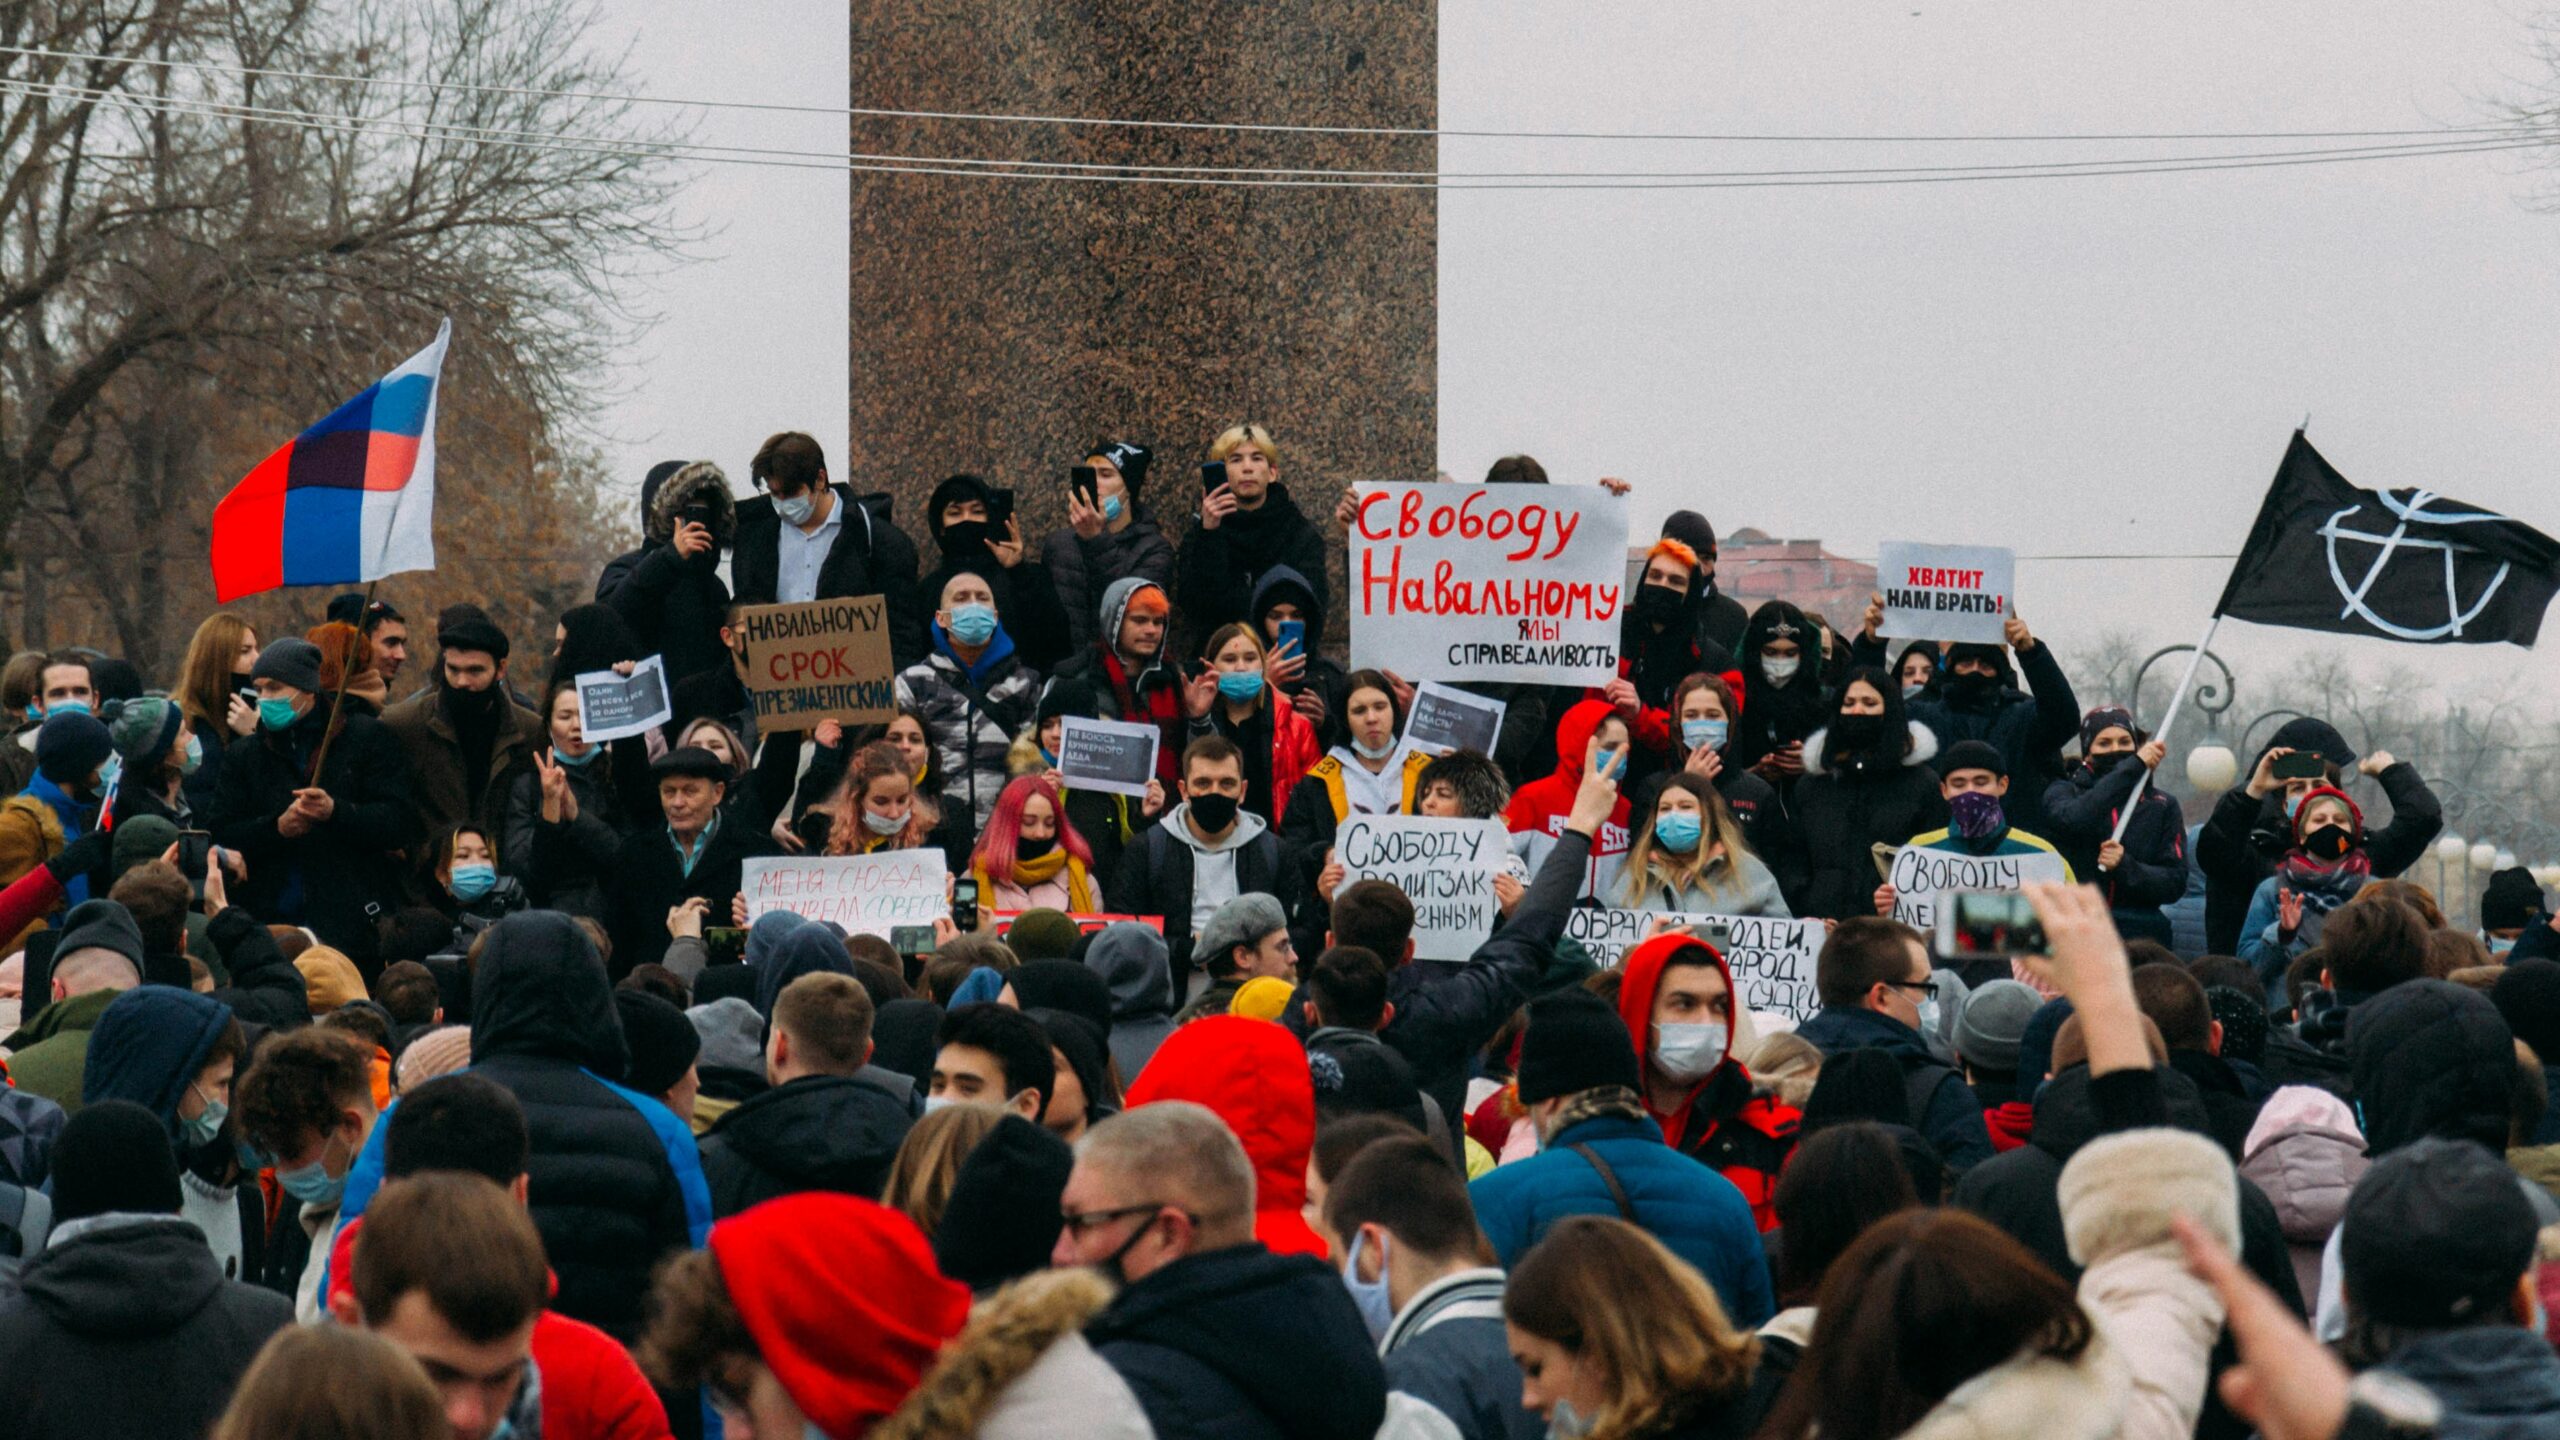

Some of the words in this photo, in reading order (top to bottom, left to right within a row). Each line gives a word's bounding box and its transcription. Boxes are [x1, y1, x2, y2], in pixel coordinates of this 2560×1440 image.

[1358, 489, 1580, 561] Свободу
[1362, 545, 1619, 621] Навальному
[1908, 566, 1984, 590] ХВАТИТ
[1887, 588, 1931, 610] НАМ
[1935, 591, 2003, 614] ВРАТЬ!
[747, 603, 882, 642] НАВАЛЬНОМУ
[769, 647, 856, 682] СРОК
[1448, 644, 1616, 669] СПРАВЕДЛИВОСТЬ
[753, 676, 894, 716] ПРЕЗИДЕНТСКИЙ
[758, 868, 825, 898] МЕНЯ
[837, 863, 922, 893] СЮДА
[1895, 850, 2020, 894] СВОБОДУ
[864, 893, 949, 919] СОВЕСТЬ
[1893, 896, 1937, 927] АЛЕ
